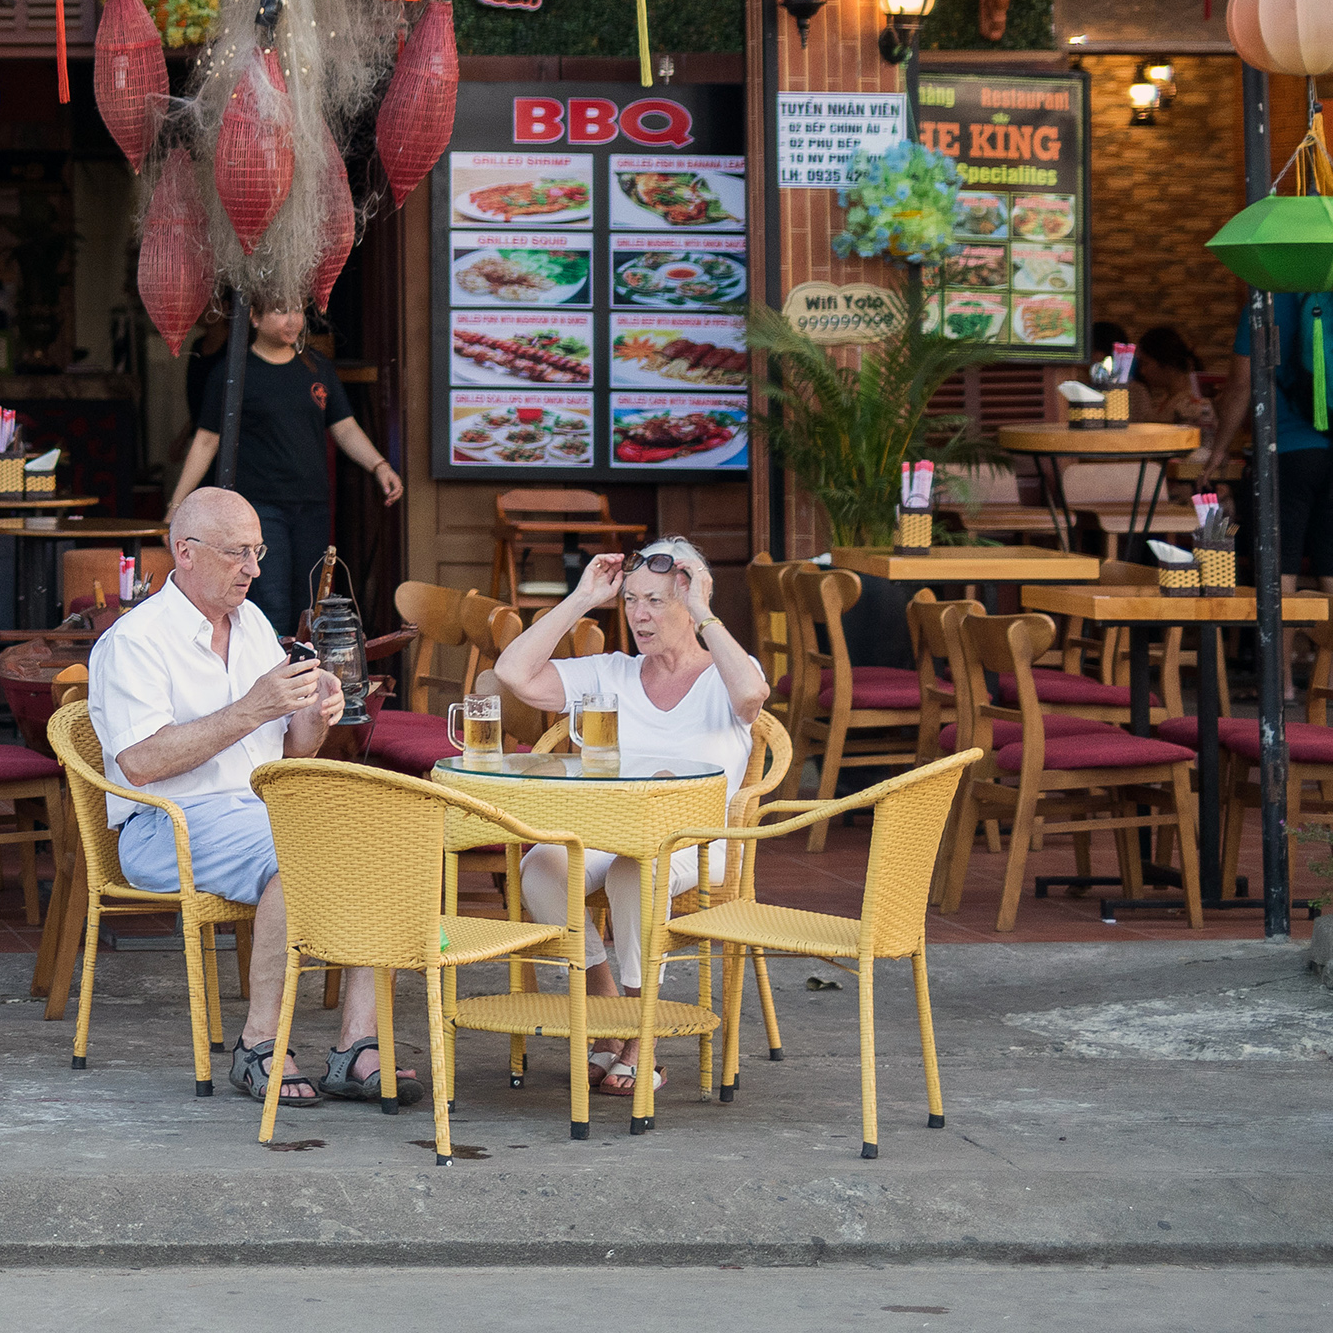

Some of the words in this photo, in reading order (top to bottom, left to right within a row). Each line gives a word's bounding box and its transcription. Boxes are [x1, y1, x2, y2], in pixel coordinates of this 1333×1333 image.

[513, 96, 695, 149] BBQ
[789, 123, 802, 133] 02
[789, 139, 804, 148] 02
[969, 123, 1062, 162] KING
[473, 156, 523, 166] GRILLED
[527, 156, 571, 166] SHRIMP
[790, 154, 804, 163] 10
[617, 159, 654, 169] GRILLED
[807, 169, 841, 182] 0935
[477, 236, 528, 246] GRILLED
[532, 236, 568, 246] SQUID
[617, 239, 647, 248] GRILLED
[805, 295, 838, 311] Wifi
[455, 395, 484, 404] GRILLED
